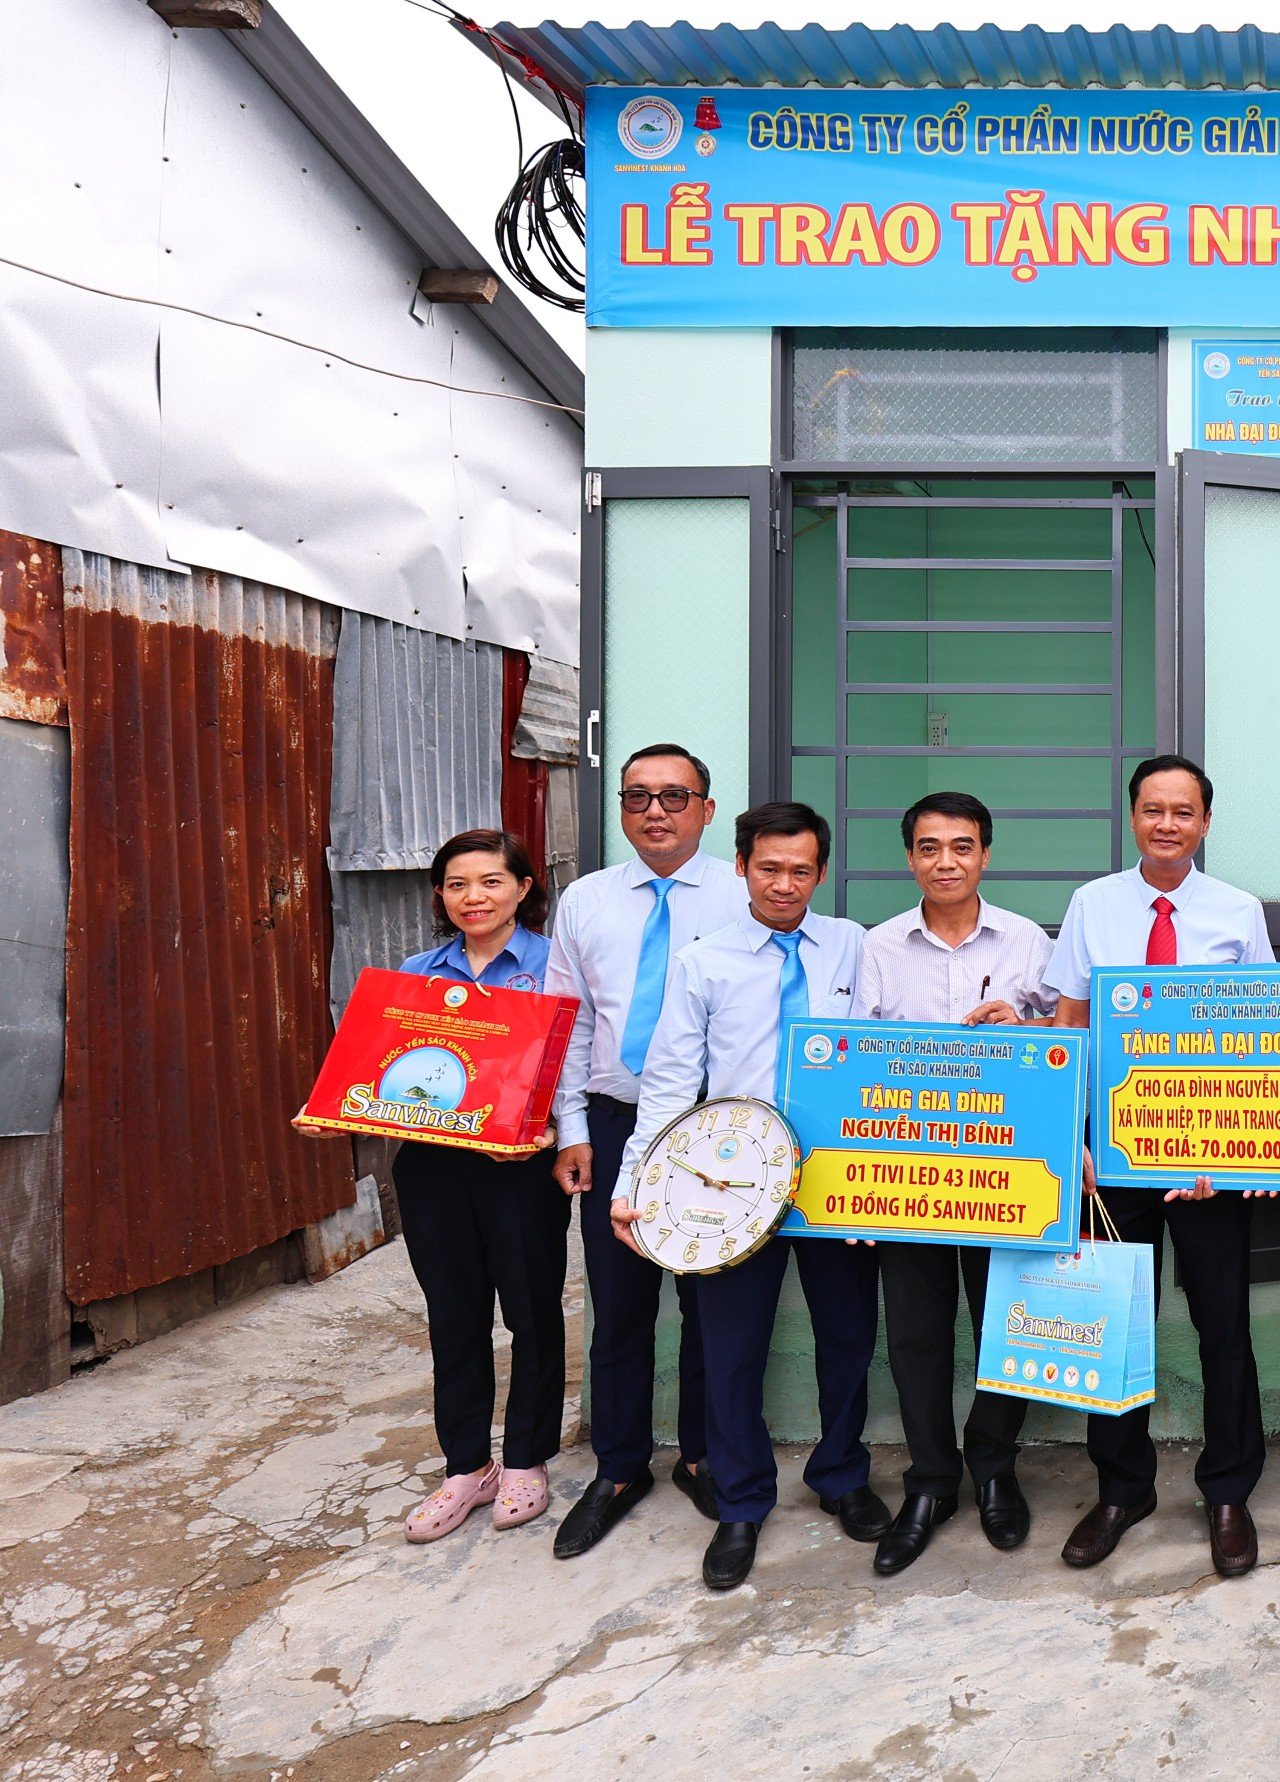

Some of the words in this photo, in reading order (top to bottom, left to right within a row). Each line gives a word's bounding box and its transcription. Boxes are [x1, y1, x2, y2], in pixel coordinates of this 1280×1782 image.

[748, 106, 854, 153] CÔNG
[860, 112, 907, 153] TY
[913, 101, 972, 154] CỔ
[976, 104, 1083, 154] PHẦN
[1087, 110, 1193, 155] NƯỚC
[1201, 106, 1279, 156] GIẢI
[615, 164, 648, 172] SANVINEST
[621, 183, 713, 266] LỄ
[723, 202, 941, 266] TRAO
[953, 190, 1169, 283] TẶNG
[1227, 389, 1271, 406] Trao
[1204, 419, 1236, 441] NHÀ
[1239, 422, 1264, 445] ĐẠI
[1161, 981, 1187, 999] CÔNG
[1188, 984, 1198, 999] TY
[1200, 979, 1215, 999] CỔ
[1216, 978, 1241, 999] PHẦN
[1242, 981, 1268, 998] NƯỚC
[1190, 1000, 1210, 1020] YẾN
[1211, 1002, 1229, 1019] SÀO
[1231, 1002, 1263, 1019] KHÁNH
[857, 1037, 884, 1054] CÔNG
[885, 1040, 897, 1055] TY
[898, 1035, 913, 1054] CỔ
[913, 1037, 941, 1056] PHẦN
[941, 1040, 967, 1058] NƯỚC
[968, 1039, 989, 1059] GIẢI
[989, 1041, 1014, 1059] KHÁT
[1121, 1028, 1170, 1059] TẶNG
[1176, 1028, 1217, 1054] NHÀ
[1221, 1032, 1254, 1059] ĐẠI
[379, 1046, 404, 1070] NƯỚC
[405, 1036, 425, 1049] YẾN
[427, 1035, 446, 1045] SÀO
[446, 1040, 472, 1063] KHÁNH
[466, 1060, 478, 1082] HÒA
[887, 1057, 907, 1076] YẾN
[907, 1060, 927, 1077] SÀO
[928, 1060, 961, 1079] KHÁNH
[962, 1062, 982, 1079] HÒA
[1135, 1079, 1161, 1097] CHO
[1164, 1080, 1186, 1097] GIA
[1189, 1077, 1222, 1098] ĐÌNH
[1226, 1073, 1279, 1098] NGUYỄN
[342, 1083, 486, 1134] Sanvinest
[860, 1083, 912, 1113] TẶNG
[918, 1090, 951, 1111] GIA
[956, 1088, 1004, 1114] ĐÌNH
[697, 1109, 719, 1131] 11
[729, 1106, 753, 1129] 12
[761, 1117, 773, 1139] 1
[1118, 1105, 1133, 1128] XÃ
[1135, 1105, 1163, 1128] VĨNH
[1166, 1105, 1195, 1134] HIỆP,
[1197, 1109, 1212, 1128] TP
[1215, 1109, 1240, 1129] NHA
[667, 1130, 690, 1152] 10
[841, 1115, 922, 1141] NGUYỄN
[926, 1122, 959, 1148] THỊ
[964, 1121, 1014, 1146] BÍNH
[769, 1145, 788, 1167] 2
[1134, 1137, 1159, 1162] TRỊ
[1164, 1135, 1197, 1158] GIÁ:
[647, 1163, 662, 1185] 9
[846, 1164, 866, 1182] 01
[872, 1164, 904, 1184] TIVI
[908, 1165, 940, 1186] LED
[943, 1168, 964, 1188] 43
[969, 1169, 1010, 1190] INCH
[770, 1181, 788, 1203] 3
[643, 1200, 660, 1222] 8
[682, 1208, 727, 1226] Sanvinest
[825, 1194, 845, 1214] 01
[851, 1190, 899, 1217] ĐỒNG
[904, 1193, 929, 1217] HỒ
[933, 1199, 1026, 1224] SANVINEST
[655, 1228, 673, 1250] 7
[746, 1216, 765, 1239] 4
[683, 1240, 700, 1263] 6
[718, 1238, 737, 1260] 5
[1008, 1301, 1103, 1345] Sanvinest
